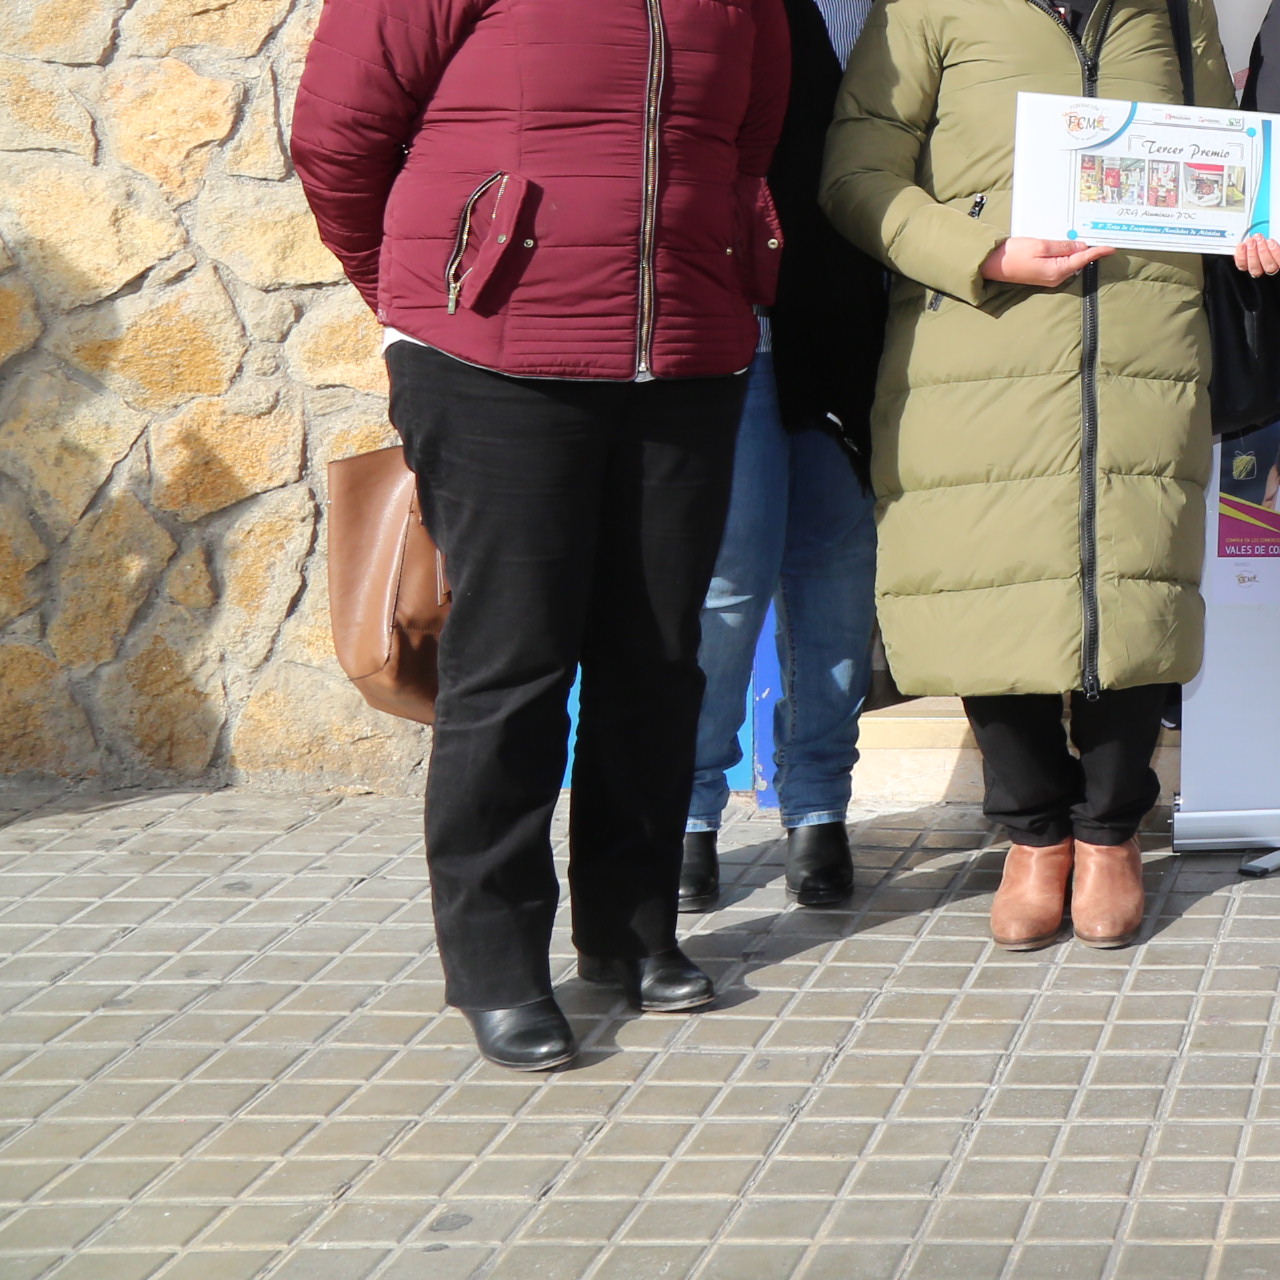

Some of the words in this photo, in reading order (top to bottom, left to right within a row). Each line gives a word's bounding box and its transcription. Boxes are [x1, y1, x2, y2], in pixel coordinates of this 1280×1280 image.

[1141, 139, 1184, 156] Tercer
[1188, 144, 1230, 160] Premio
[1225, 545, 1252, 554] VALES
[1255, 545, 1266, 554] DE
